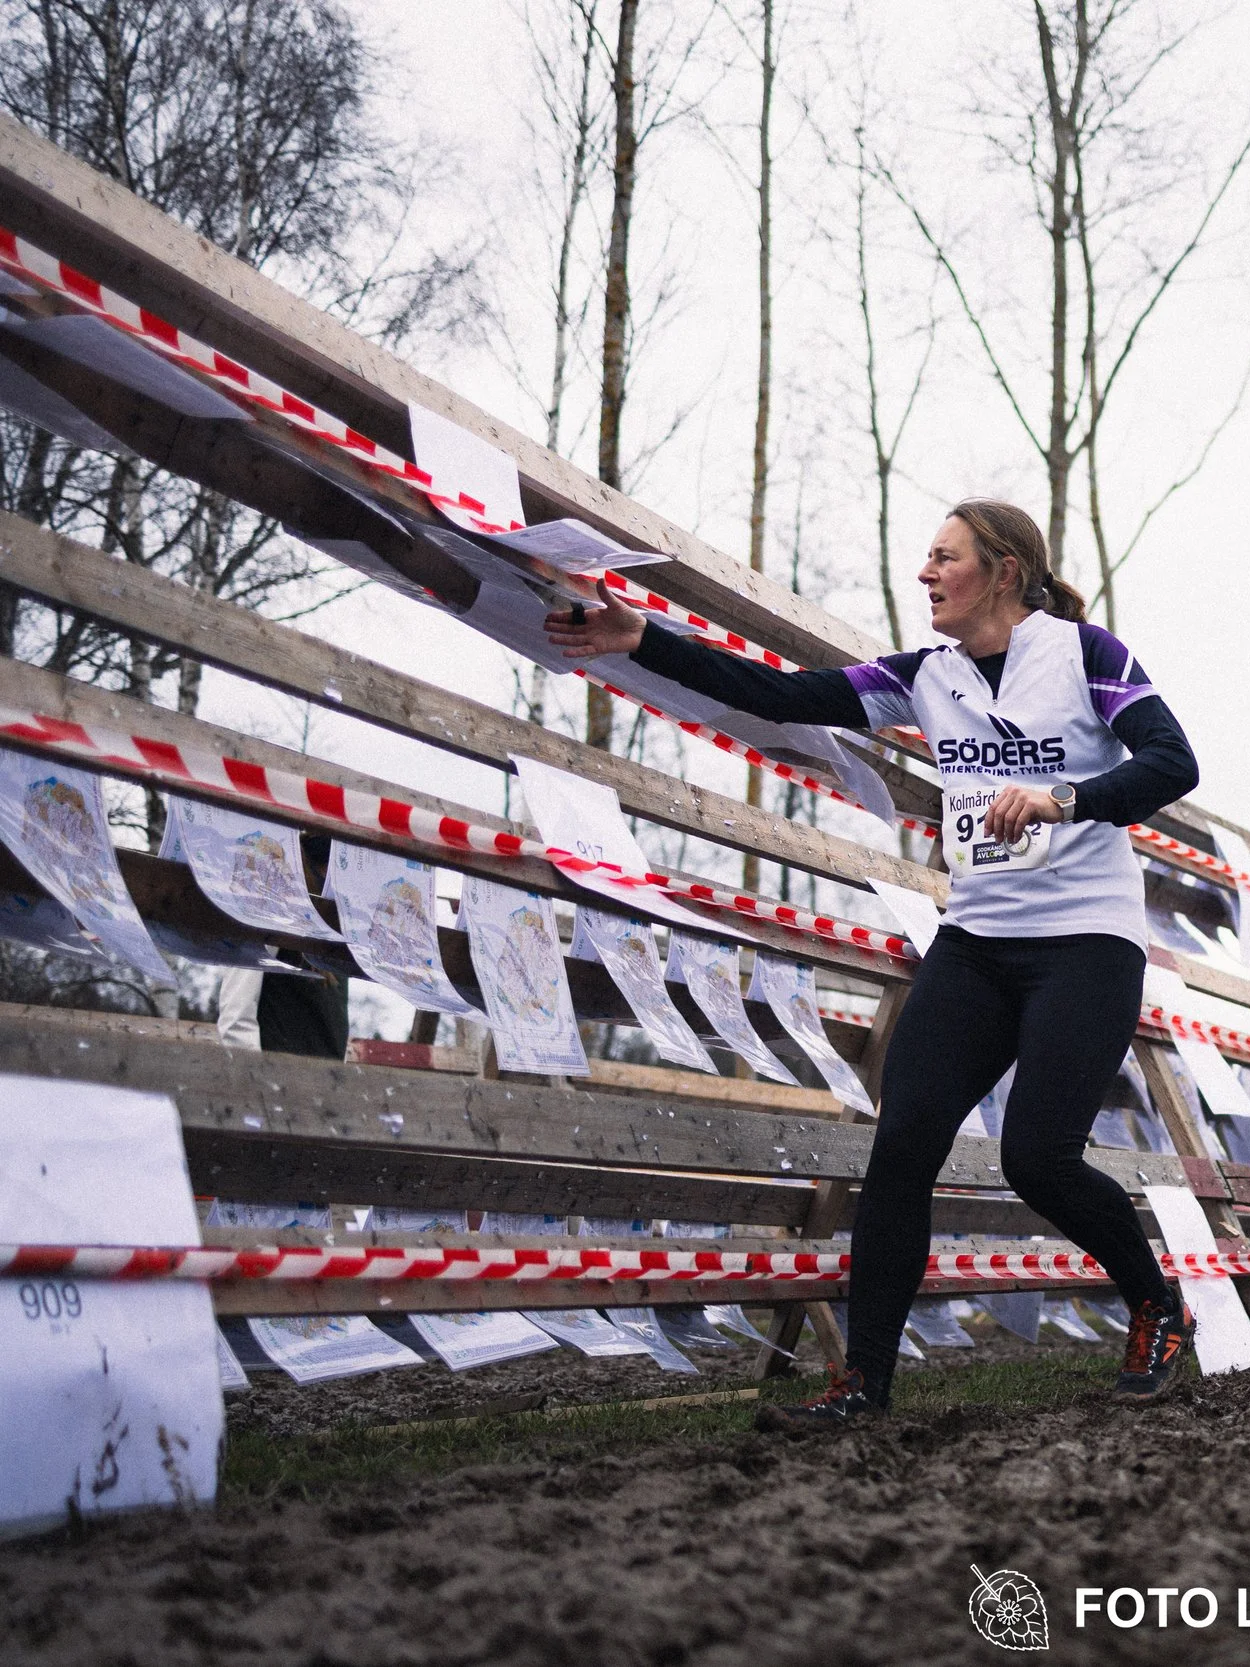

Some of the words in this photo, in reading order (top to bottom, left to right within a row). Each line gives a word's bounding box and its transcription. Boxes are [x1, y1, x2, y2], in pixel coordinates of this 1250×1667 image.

[937, 737, 1066, 767] SÖDERS
[949, 790, 1000, 813] Kolmård
[20, 1282, 82, 1320] 909
